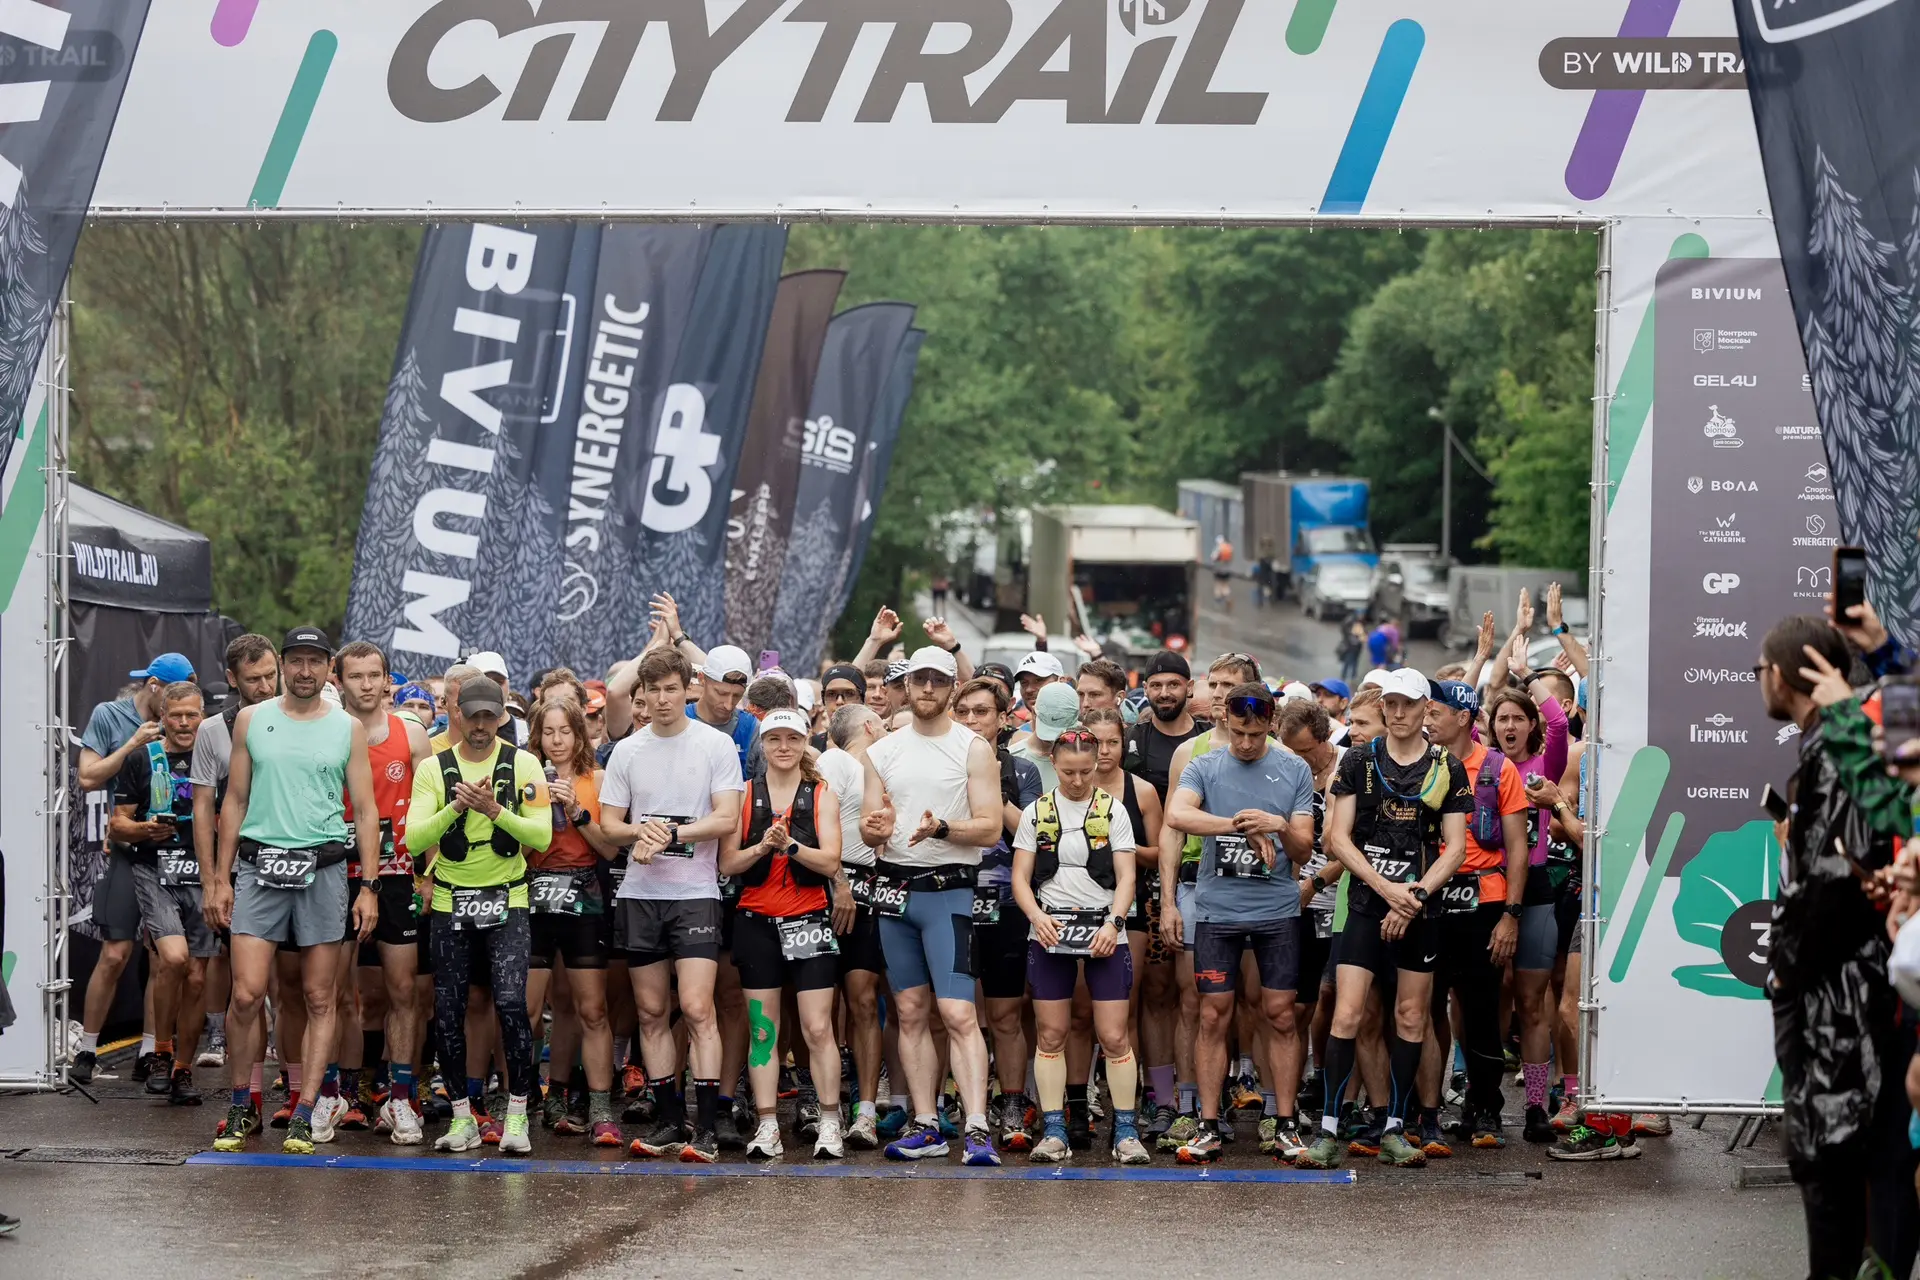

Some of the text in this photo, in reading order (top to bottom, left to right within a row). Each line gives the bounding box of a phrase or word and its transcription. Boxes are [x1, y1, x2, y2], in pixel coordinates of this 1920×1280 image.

[1564, 52, 1602, 73] BY
[1613, 52, 1692, 73] WILD
[1692, 288, 1761, 300] BIVIUM
[1718, 329, 1758, 338] Контроль
[1693, 375, 1757, 387] GEL4U
[565, 293, 650, 551] SYNERGETIC
[1705, 424, 1735, 435] bionova
[391, 223, 537, 659] BIVIUM
[640, 382, 721, 534] GP
[1797, 493, 1835, 501] Марафон
[1804, 486, 1831, 494] Спорт-
[1792, 537, 1838, 547] SYNERGETIC
[72, 542, 159, 586] WILDTRAIL.RU
[1703, 572, 1740, 594] GP
[1695, 622, 1747, 638] SHOCK
[1700, 669, 1756, 684] MyRace
[1687, 787, 1749, 799] UGREEN
[164, 859, 199, 874] 3181
[259, 859, 312, 876] 3037
[1372, 857, 1411, 877] 3137
[534, 887, 578, 904] 3175
[849, 878, 870, 897] 145
[872, 886, 907, 905] 3065
[1442, 886, 1474, 902] 140
[454, 901, 506, 917] 3096
[972, 899, 997, 914] 83
[783, 927, 833, 949] 3008
[1057, 925, 1100, 942] 3127
